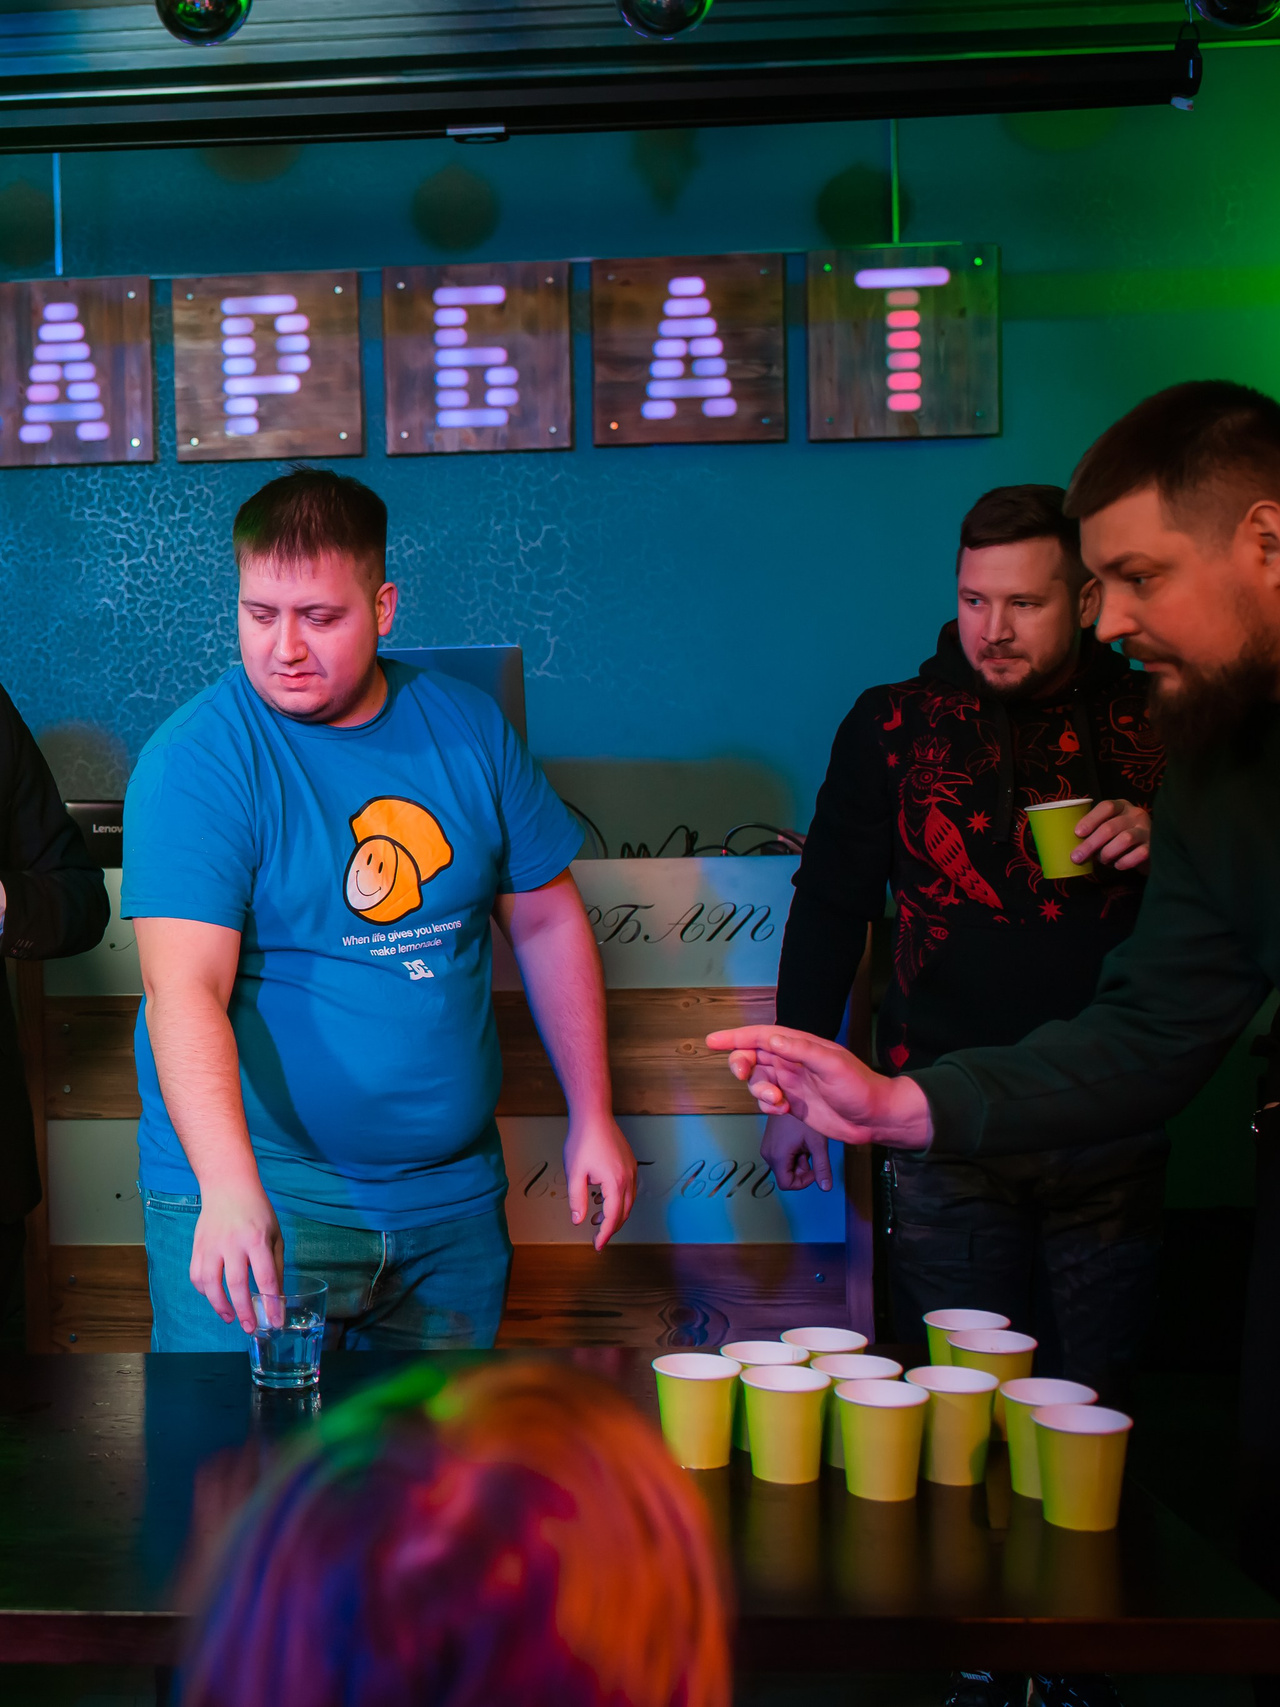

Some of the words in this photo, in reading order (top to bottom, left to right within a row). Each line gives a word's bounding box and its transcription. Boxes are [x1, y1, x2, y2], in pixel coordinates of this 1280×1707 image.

[17, 265, 951, 444] АРБАТ
[93, 824, 123, 833] Lenov
[342, 935, 370, 947] When
[372, 932, 387, 943] life
[388, 929, 413, 941] gives
[415, 927, 432, 938] you
[432, 920, 462, 933] lemons
[586, 902, 775, 944] БАТ
[370, 946, 396, 957] make
